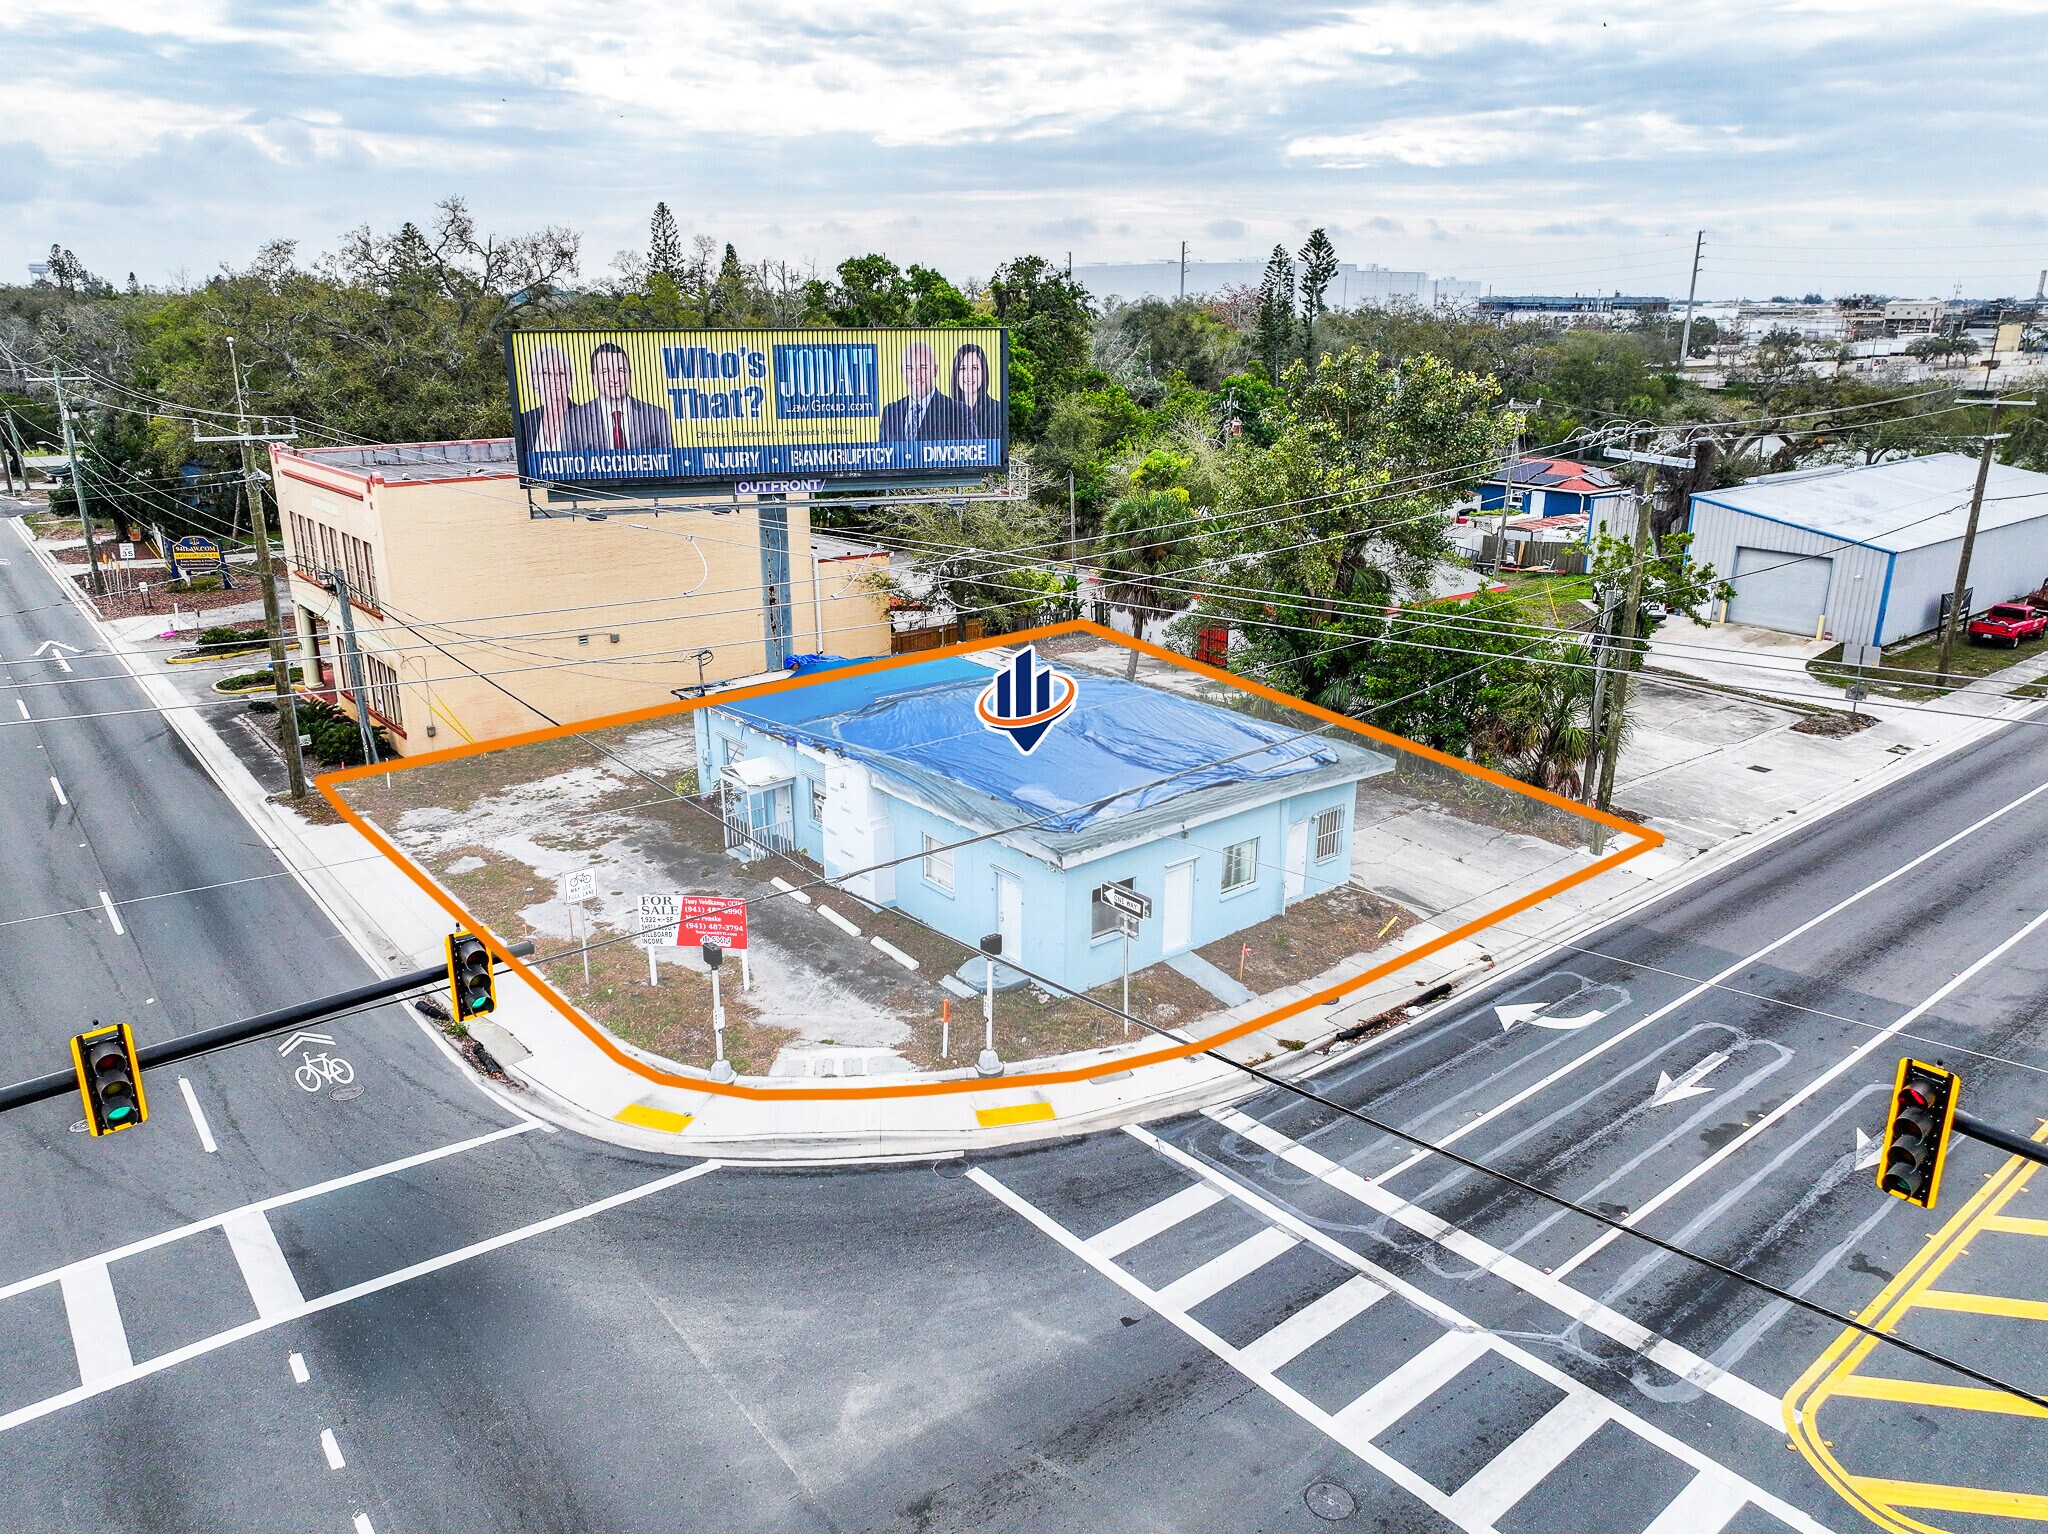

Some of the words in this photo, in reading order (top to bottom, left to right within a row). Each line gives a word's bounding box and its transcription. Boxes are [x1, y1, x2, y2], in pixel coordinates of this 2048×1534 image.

[661, 346, 766, 379] Who's
[780, 348, 873, 397] JODAT
[669, 385, 765, 420] That?
[786, 401, 809, 413] Law
[811, 400, 845, 414] Group
[733, 429, 776, 438] Bradenton
[827, 427, 854, 436] Venice
[540, 455, 586, 475] AUTO
[589, 453, 672, 474] ACCIDENT
[703, 451, 760, 469] INJURY
[790, 447, 894, 466] BANKRUPTCY
[923, 444, 987, 463] DIVORCE
[738, 479, 824, 493] OUTFRONT
[641, 896, 673, 906] FOR
[1114, 894, 1125, 905] ONE
[1126, 901, 1138, 909] WAY
[641, 905, 680, 915] SALE
[708, 924, 744, 932] 487-3794
